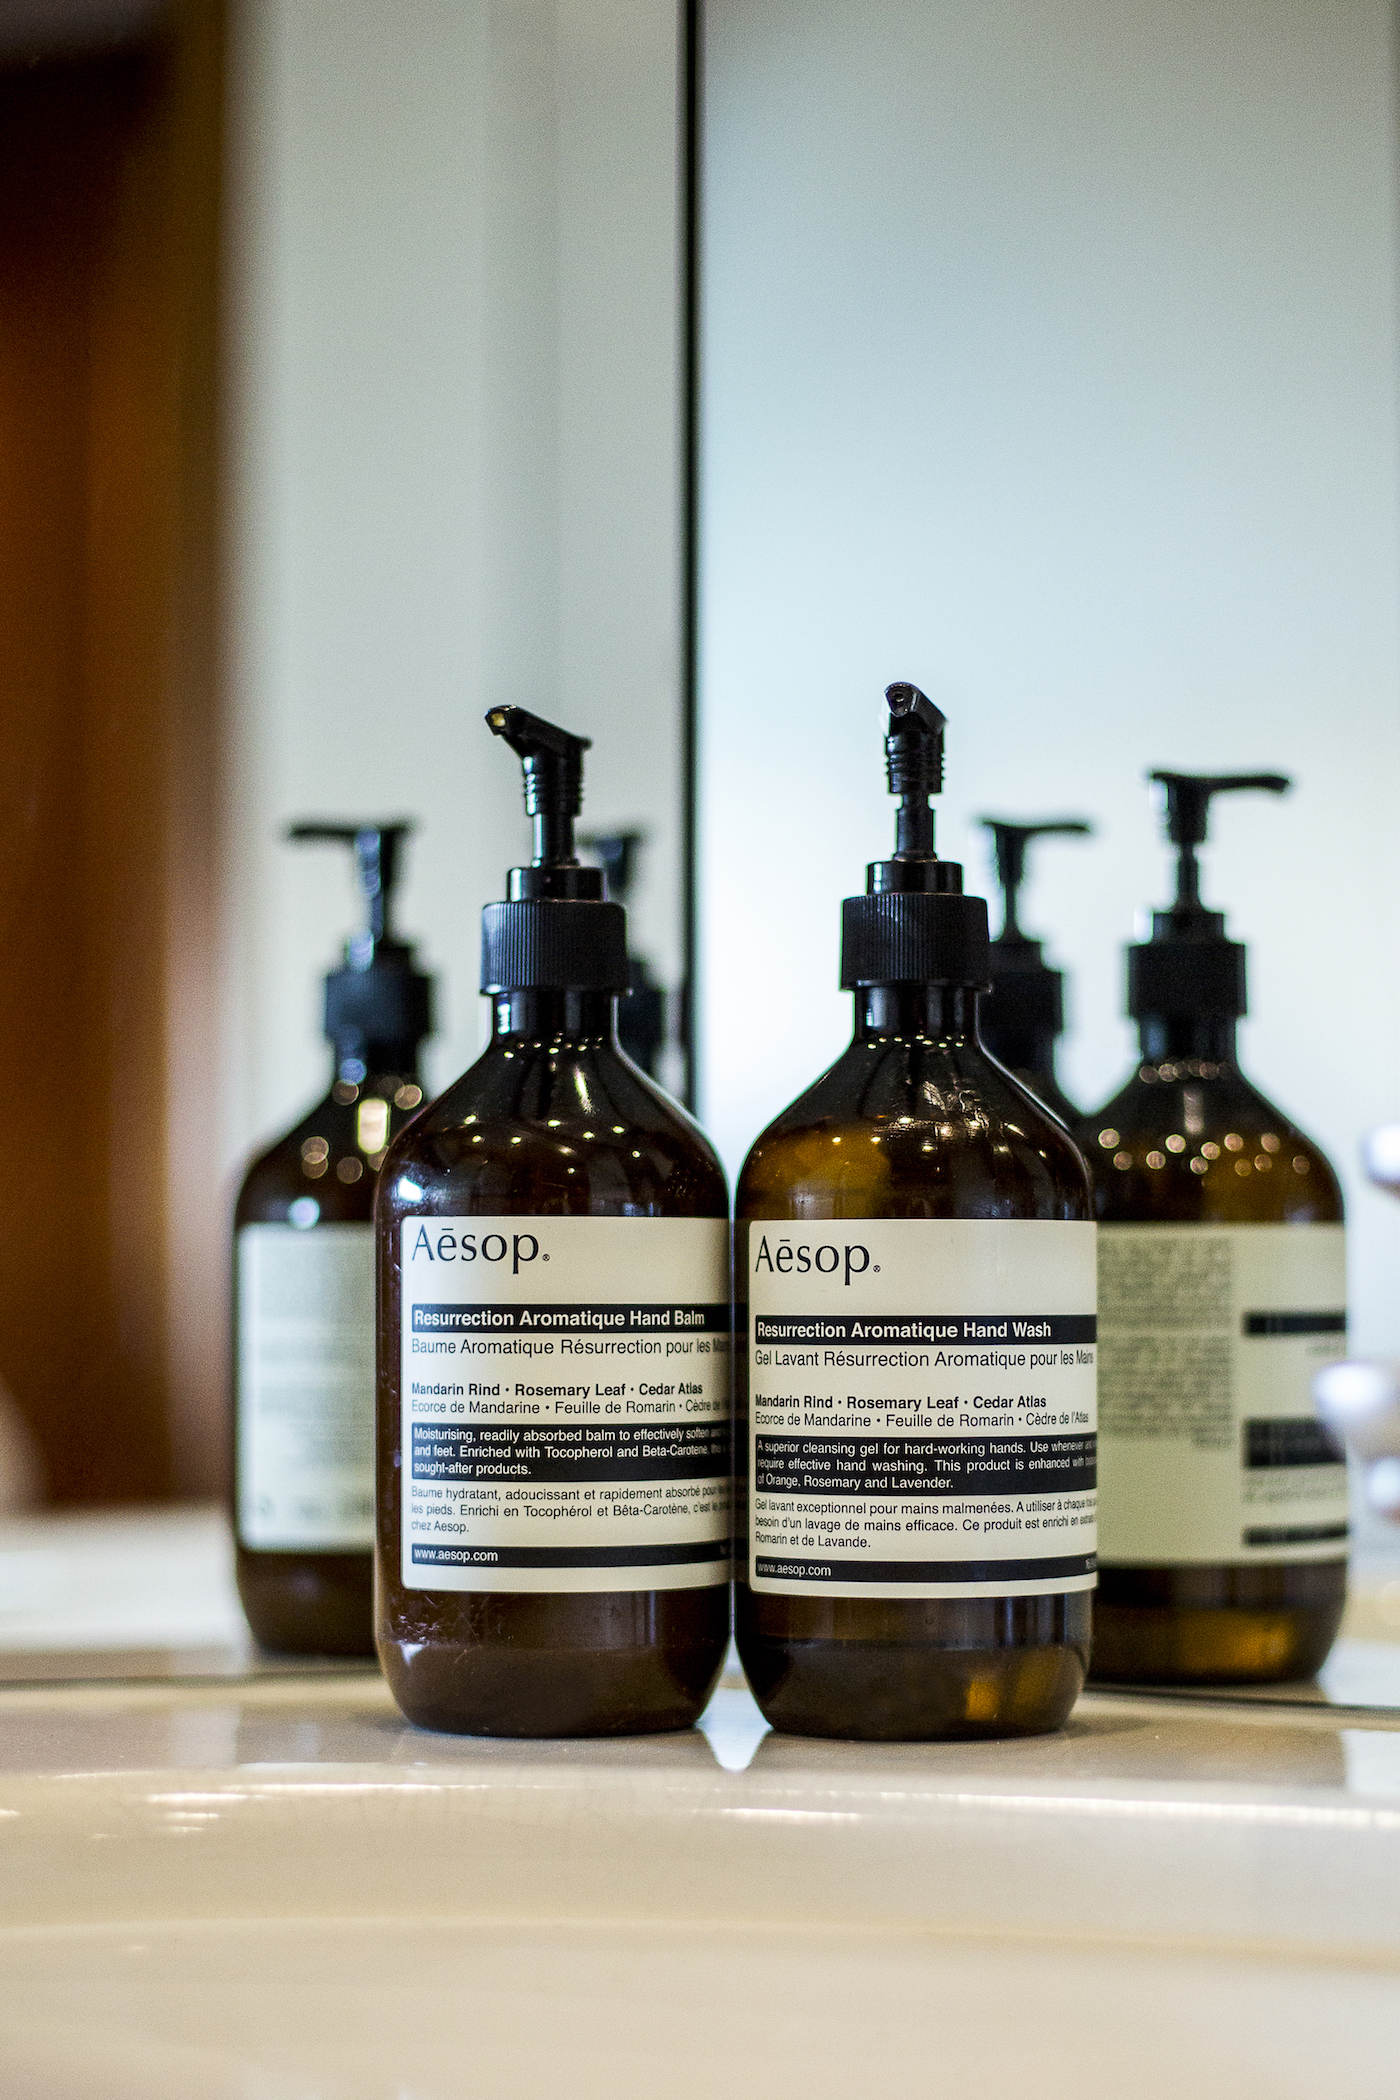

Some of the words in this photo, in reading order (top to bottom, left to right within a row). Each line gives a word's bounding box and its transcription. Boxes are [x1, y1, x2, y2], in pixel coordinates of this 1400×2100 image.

[415, 1310, 514, 1326] Resurrection
[519, 1310, 625, 1330] Aromatique
[630, 1310, 670, 1325] Hand
[675, 1310, 704, 1325] Balm
[758, 1321, 846, 1338] Resurrection
[851, 1322, 958, 1341] Aromatique
[964, 1322, 1007, 1337] Hand
[1012, 1322, 1051, 1337] Wash
[413, 1339, 456, 1353] Baume
[461, 1339, 553, 1358] Aromatique
[562, 1339, 661, 1354] Résurrection
[667, 1342, 693, 1357] pour
[697, 1339, 710, 1353] les
[755, 1350, 771, 1365] Gel
[776, 1351, 818, 1366] Lavant
[825, 1351, 928, 1366] Résurrection
[935, 1351, 1025, 1369] Aromatique
[1031, 1354, 1057, 1369] pour
[1061, 1350, 1073, 1364] les
[1076, 1350, 1093, 1364] Mains
[413, 1383, 463, 1395] Mandarin
[469, 1384, 499, 1395] Rind
[516, 1384, 590, 1399] Rosemary
[596, 1384, 625, 1395] Leaf
[639, 1383, 675, 1395] Cedar
[678, 1382, 702, 1394] Atlas
[412, 1400, 446, 1412] Ecorce
[450, 1401, 464, 1413] de
[470, 1401, 539, 1413] Mandarine
[556, 1402, 600, 1413] Feuille
[605, 1401, 621, 1413] de
[627, 1401, 675, 1413] Romarin
[686, 1399, 711, 1412] Cèdre
[756, 1394, 799, 1407] Mandarin
[804, 1396, 832, 1408] Rind
[847, 1396, 921, 1412] Rosemary
[927, 1396, 959, 1408] Leaf
[974, 1396, 1013, 1408] Cedar
[1017, 1396, 1046, 1407] Atlas
[756, 1412, 784, 1425] Ecorce
[788, 1413, 800, 1425] de
[805, 1413, 871, 1426] Mandarine
[887, 1414, 932, 1426] Feuille
[937, 1415, 954, 1426] de
[960, 1414, 1013, 1426] Romarin
[1026, 1413, 1056, 1425] Cèdre
[1059, 1412, 1069, 1424] de
[415, 1428, 476, 1442] Moisturising,
[479, 1429, 520, 1443] readily
[523, 1430, 582, 1441] absorbed
[586, 1429, 615, 1441] balm
[619, 1430, 630, 1440] to
[634, 1428, 684, 1441] effectively
[415, 1445, 430, 1456] and
[434, 1445, 455, 1457] feet.
[460, 1445, 511, 1457] Enriched
[515, 1446, 540, 1458] with
[544, 1446, 612, 1460] Tocopherol
[617, 1445, 638, 1457] and
[758, 1440, 763, 1450] A
[765, 1441, 799, 1454] superior
[803, 1442, 855, 1457] cleansing
[860, 1443, 878, 1457] gel
[884, 1443, 900, 1454] for
[905, 1443, 985, 1457] hard-working
[990, 1442, 1026, 1453] hands.
[1030, 1441, 1048, 1453] Use
[1052, 1439, 1083, 1451] whenever
[415, 1462, 473, 1476] sought-after
[476, 1463, 531, 1476] products.
[758, 1457, 784, 1473] require
[788, 1458, 831, 1470] effective
[837, 1460, 866, 1471] hand
[872, 1460, 927, 1474] washing.
[934, 1460, 961, 1471] This
[967, 1459, 1010, 1474] product
[1015, 1459, 1024, 1470] is
[1029, 1457, 1070, 1469] enhanced
[758, 1475, 764, 1486] of
[804, 1475, 861, 1491] Rosemary
[865, 1477, 887, 1488] and
[892, 1477, 953, 1488] Lavender.
[412, 1486, 442, 1498] Baume
[447, 1488, 500, 1501] hydratant,
[506, 1489, 579, 1500] adoucissant
[584, 1490, 595, 1500] et
[600, 1488, 662, 1502] rapidement
[666, 1486, 700, 1498] absorbé
[412, 1504, 423, 1514] les
[427, 1503, 455, 1516] pieds.
[461, 1505, 498, 1516] Enrichi
[504, 1508, 518, 1516] en
[526, 1506, 591, 1519] Tocophérol
[597, 1506, 608, 1516] et
[612, 1502, 690, 1516] Bêta-Carotène,
[755, 1498, 768, 1510] Gel
[769, 1499, 794, 1511] lavant
[797, 1502, 866, 1515] exceptionnel
[870, 1505, 897, 1516] pour
[902, 1503, 938, 1514] mains
[943, 1502, 1014, 1513] malmenées.
[1017, 1502, 1024, 1512] A
[1026, 1500, 1055, 1512] utiliser
[1057, 1499, 1062, 1510] à
[1063, 1496, 1085, 1511] chaque
[412, 1521, 431, 1530] chez
[434, 1521, 469, 1534] Aesop.
[755, 1514, 779, 1528] besoin
[782, 1517, 801, 1528] d'un
[805, 1518, 840, 1533] lavage
[845, 1519, 859, 1530] de
[865, 1519, 901, 1531] mains
[906, 1520, 957, 1531] efficace.
[963, 1519, 979, 1530] Ce
[984, 1519, 1021, 1532] produit
[1025, 1518, 1039, 1529] est
[1043, 1516, 1068, 1528] enrichi
[1071, 1517, 1078, 1526] en
[756, 1531, 787, 1544] Romarin
[790, 1535, 798, 1545] et
[802, 1535, 814, 1546] de
[818, 1535, 870, 1547] Lavande.
[415, 1548, 498, 1564] www.aesop.com
[758, 1560, 831, 1577] www.aesop.com
